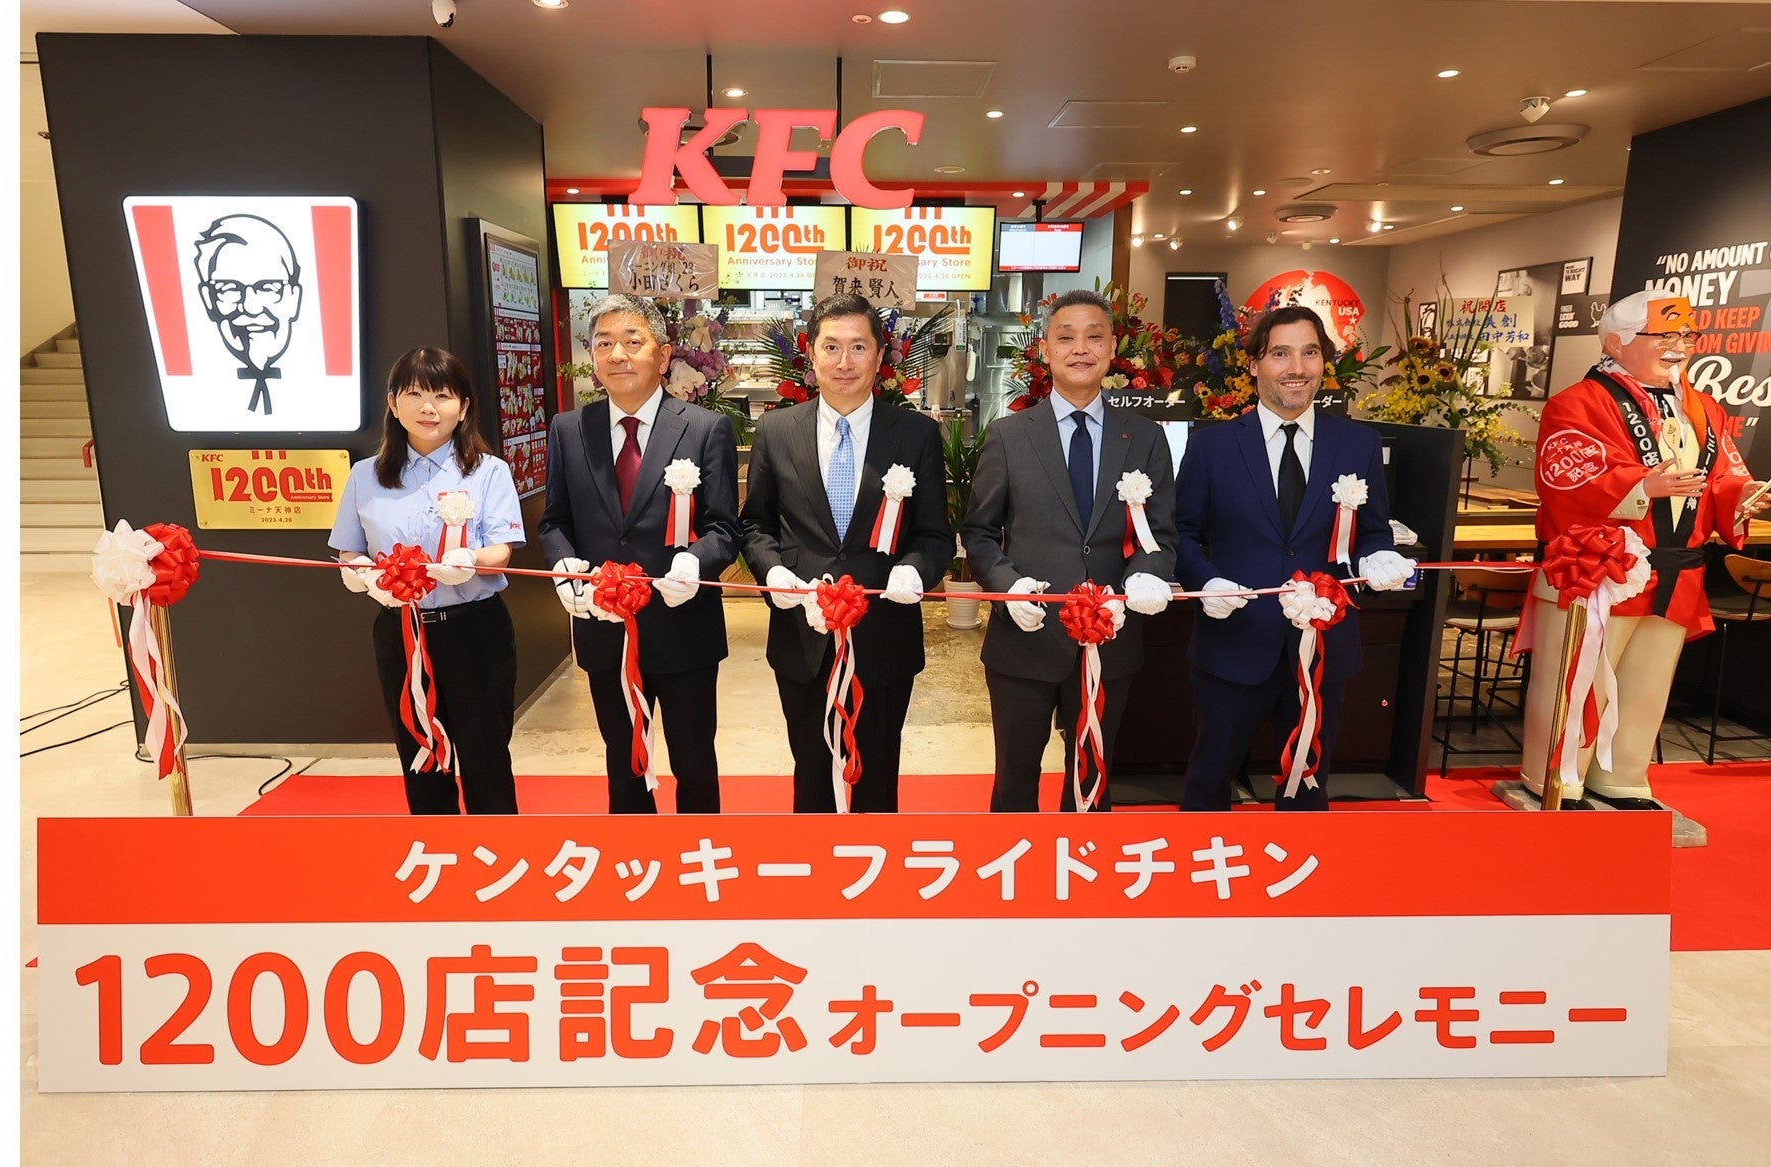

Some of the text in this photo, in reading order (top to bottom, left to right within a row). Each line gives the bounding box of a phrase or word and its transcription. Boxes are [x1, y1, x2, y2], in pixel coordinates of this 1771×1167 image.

[627, 107, 926, 209] KFC
[725, 223, 825, 254] 1200th
[873, 224, 972, 255] 1200th
[727, 257, 817, 267] Anniversary Sto
[846, 256, 888, 272] 御祝
[942, 259, 971, 267] Store
[1690, 242, 1768, 272] AMOUNT
[1315, 299, 1360, 307] KENTUCKY
[1338, 307, 1360, 316] USA
[1460, 299, 1508, 313] 祝開店
[1714, 306, 1761, 329] KEEP
[201, 453, 224, 462] KFC
[210, 466, 333, 503] 1200th
[249, 506, 301, 514] ミーナ天神店
[396, 837, 1319, 903] ケンタッキーフライドチキン
[76, 943, 1628, 1067] 1200店記念 オープニングセレモニー
